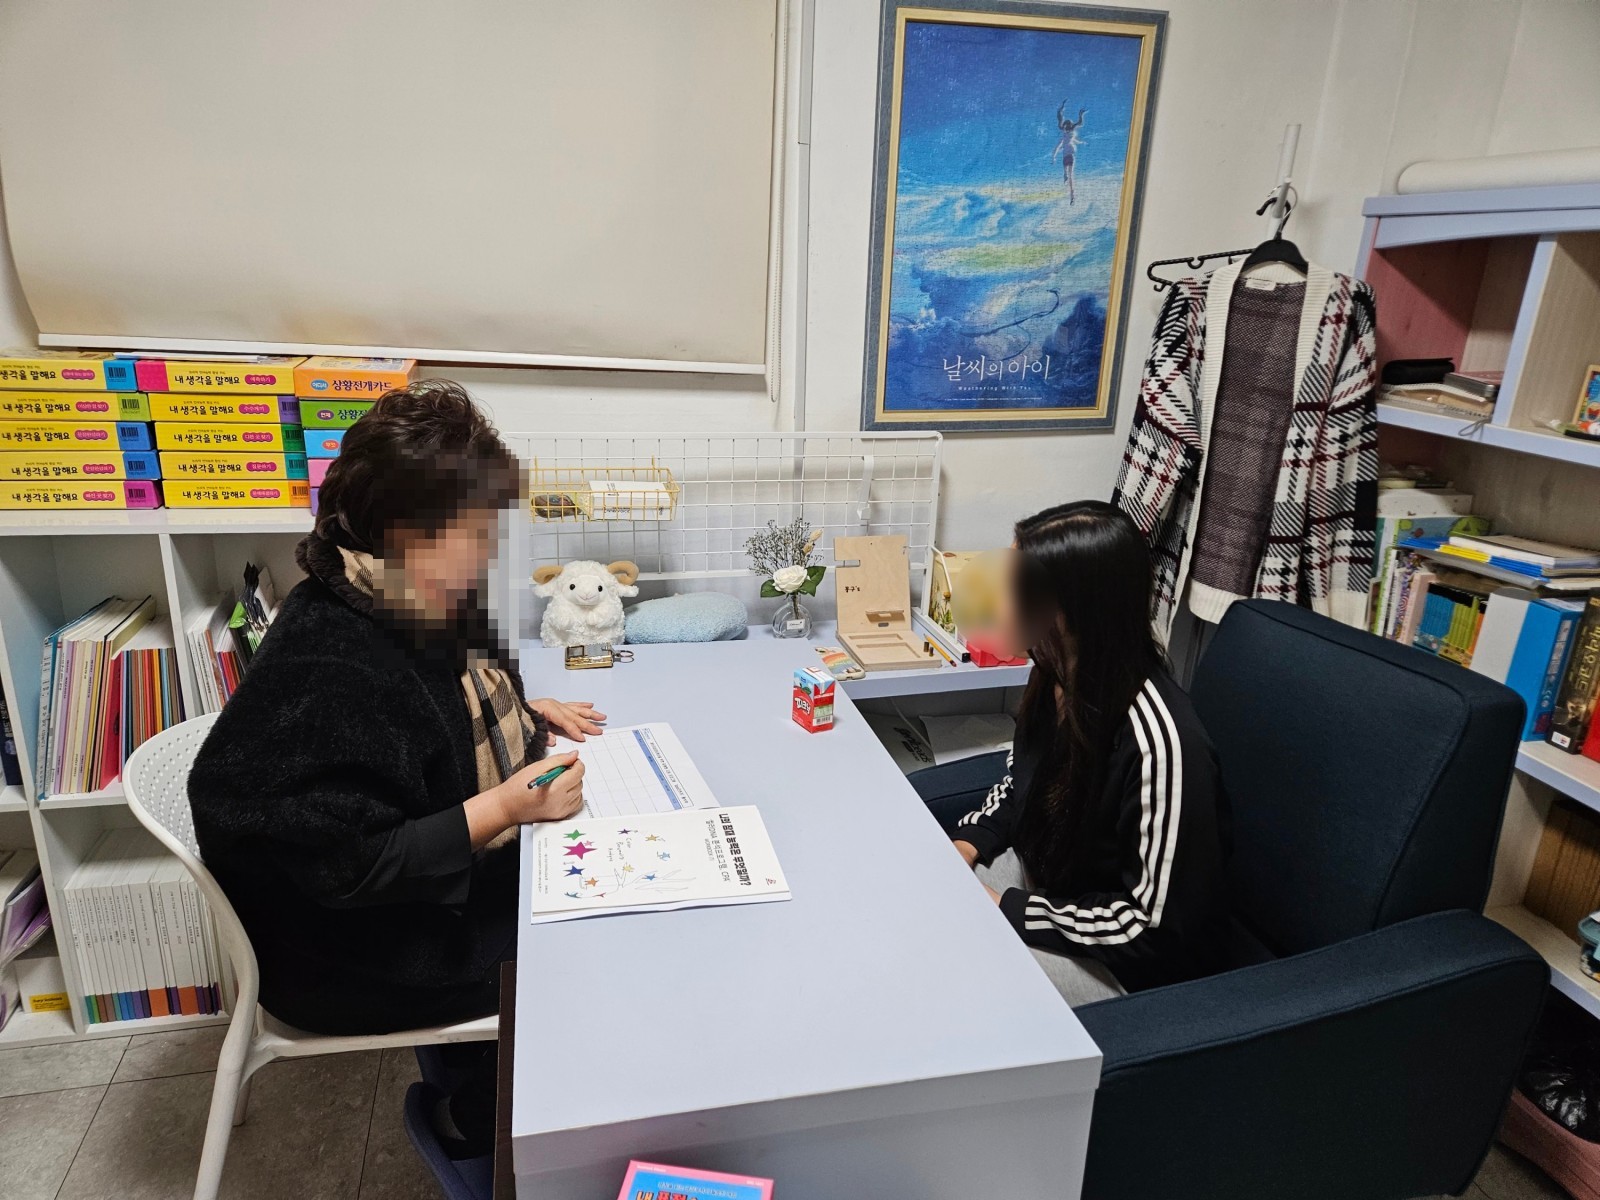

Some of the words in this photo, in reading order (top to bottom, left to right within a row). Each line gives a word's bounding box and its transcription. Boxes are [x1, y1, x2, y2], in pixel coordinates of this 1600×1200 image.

[30, 371, 57, 381] 말해요
[175, 375, 184, 384] 내
[186, 375, 213, 386] 생각을
[215, 375, 240, 385] 말해요
[332, 379, 393, 391] 상황전개카드
[2, 403, 12, 412] 내
[14, 402, 42, 413] 생각을
[44, 402, 72, 413] 말해요
[169, 405, 179, 414] 내
[181, 404, 207, 415] 생각을
[209, 405, 235, 415] 말해요
[2, 432, 11, 440] 내
[13, 431, 42, 442] 생각을
[44, 431, 71, 442] 말해요
[173, 434, 183, 442] 내
[184, 433, 212, 444] 생각을
[213, 434, 239, 444] 말해요
[11, 467, 21, 475] 내
[22, 466, 50, 477] 생각을
[52, 466, 78, 476] 말해요
[178, 463, 187, 473] 내
[188, 463, 215, 474] 생각을
[217, 463, 242, 474] 말해요
[11, 493, 21, 502] 내
[22, 492, 51, 504] 생각을
[52, 492, 78, 503] 말해요
[182, 490, 192, 499] 내
[193, 490, 219, 501] 생각을
[221, 491, 246, 500] 말해요
[726, 837, 742, 856] 능력은
[733, 856, 752, 886] 무엇일까?
